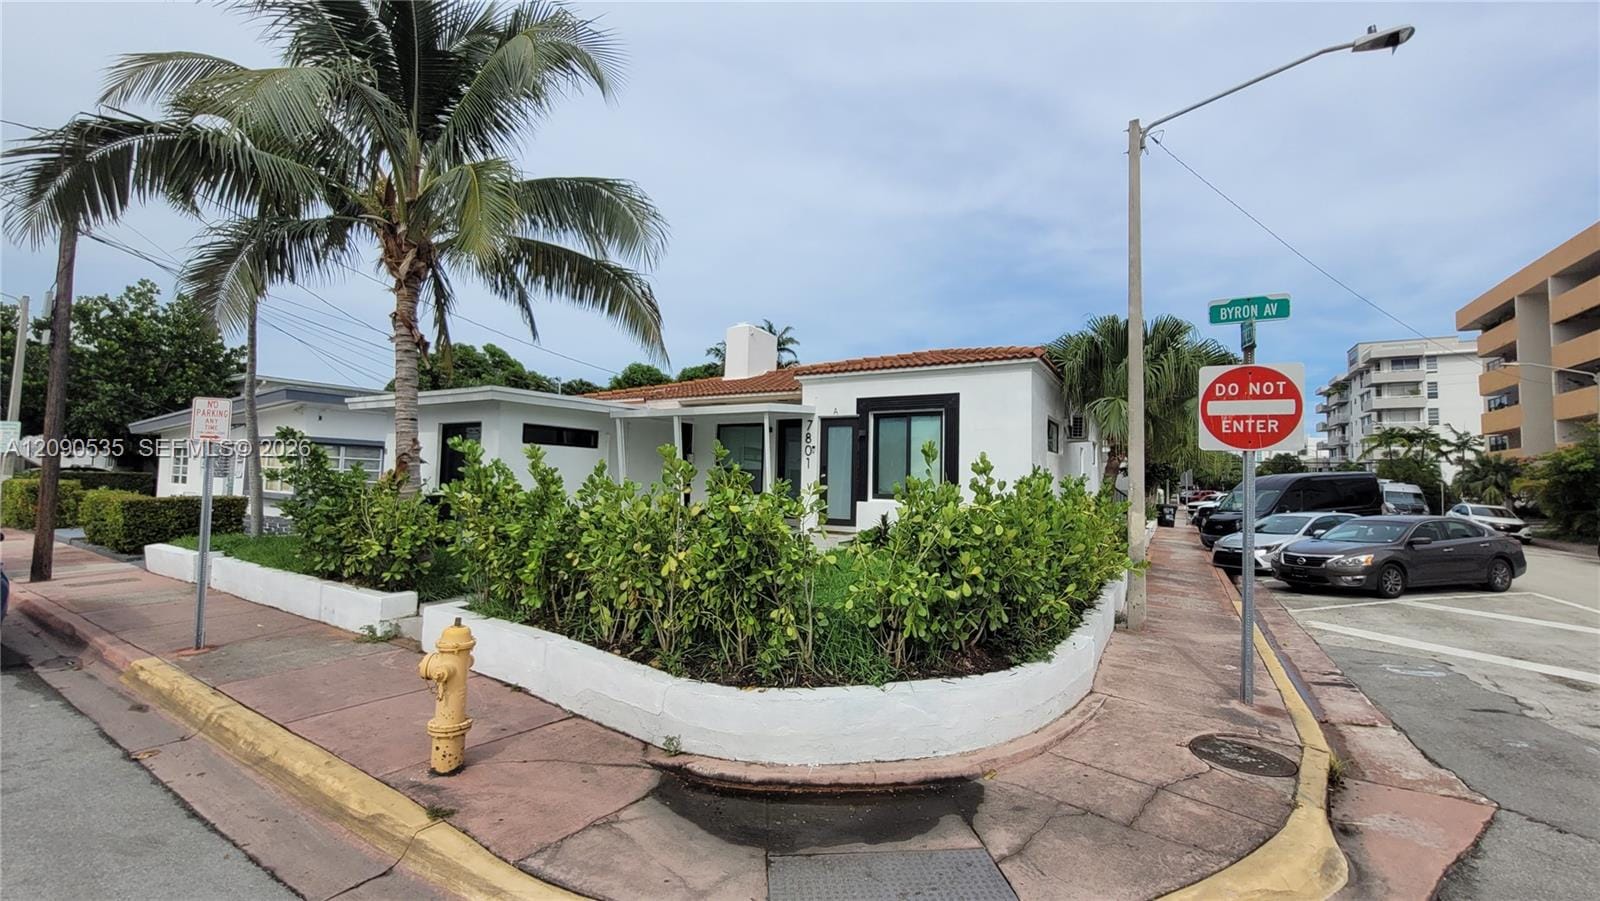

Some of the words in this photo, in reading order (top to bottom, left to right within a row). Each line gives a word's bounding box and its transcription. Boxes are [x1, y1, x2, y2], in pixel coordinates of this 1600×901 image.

[1220, 304, 1258, 320] BYRON
[1263, 302, 1278, 316] AV
[1215, 383, 1239, 396] DO
[1249, 381, 1286, 395] NOT
[207, 400, 219, 408] NO
[196, 408, 229, 417] PARKING
[1221, 420, 1279, 433] ENTER
